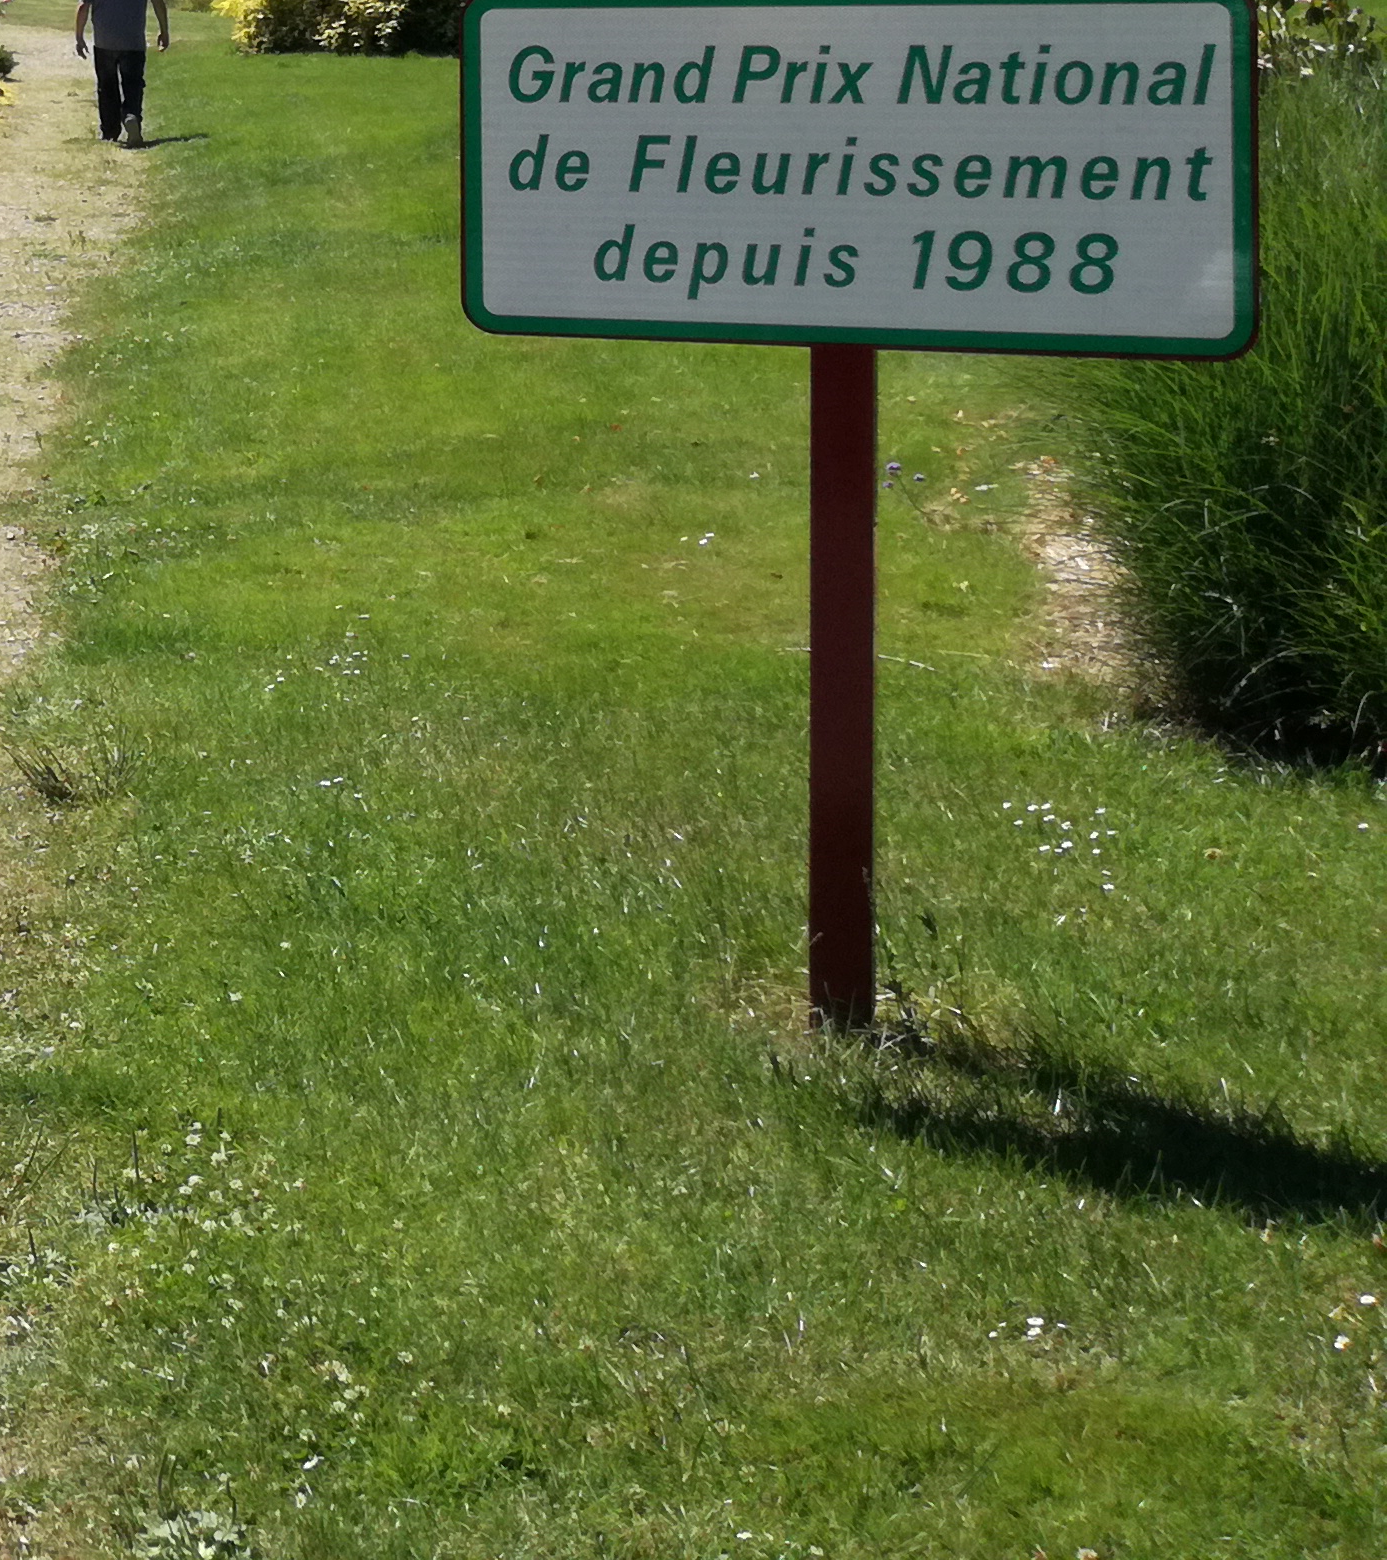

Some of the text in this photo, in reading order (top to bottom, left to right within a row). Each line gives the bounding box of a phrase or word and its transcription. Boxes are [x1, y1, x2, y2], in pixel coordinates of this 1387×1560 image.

[508, 43, 1217, 106] Grand Prix National
[508, 134, 1212, 202] de Fleurissement
[594, 225, 1120, 299] depuis 1988
